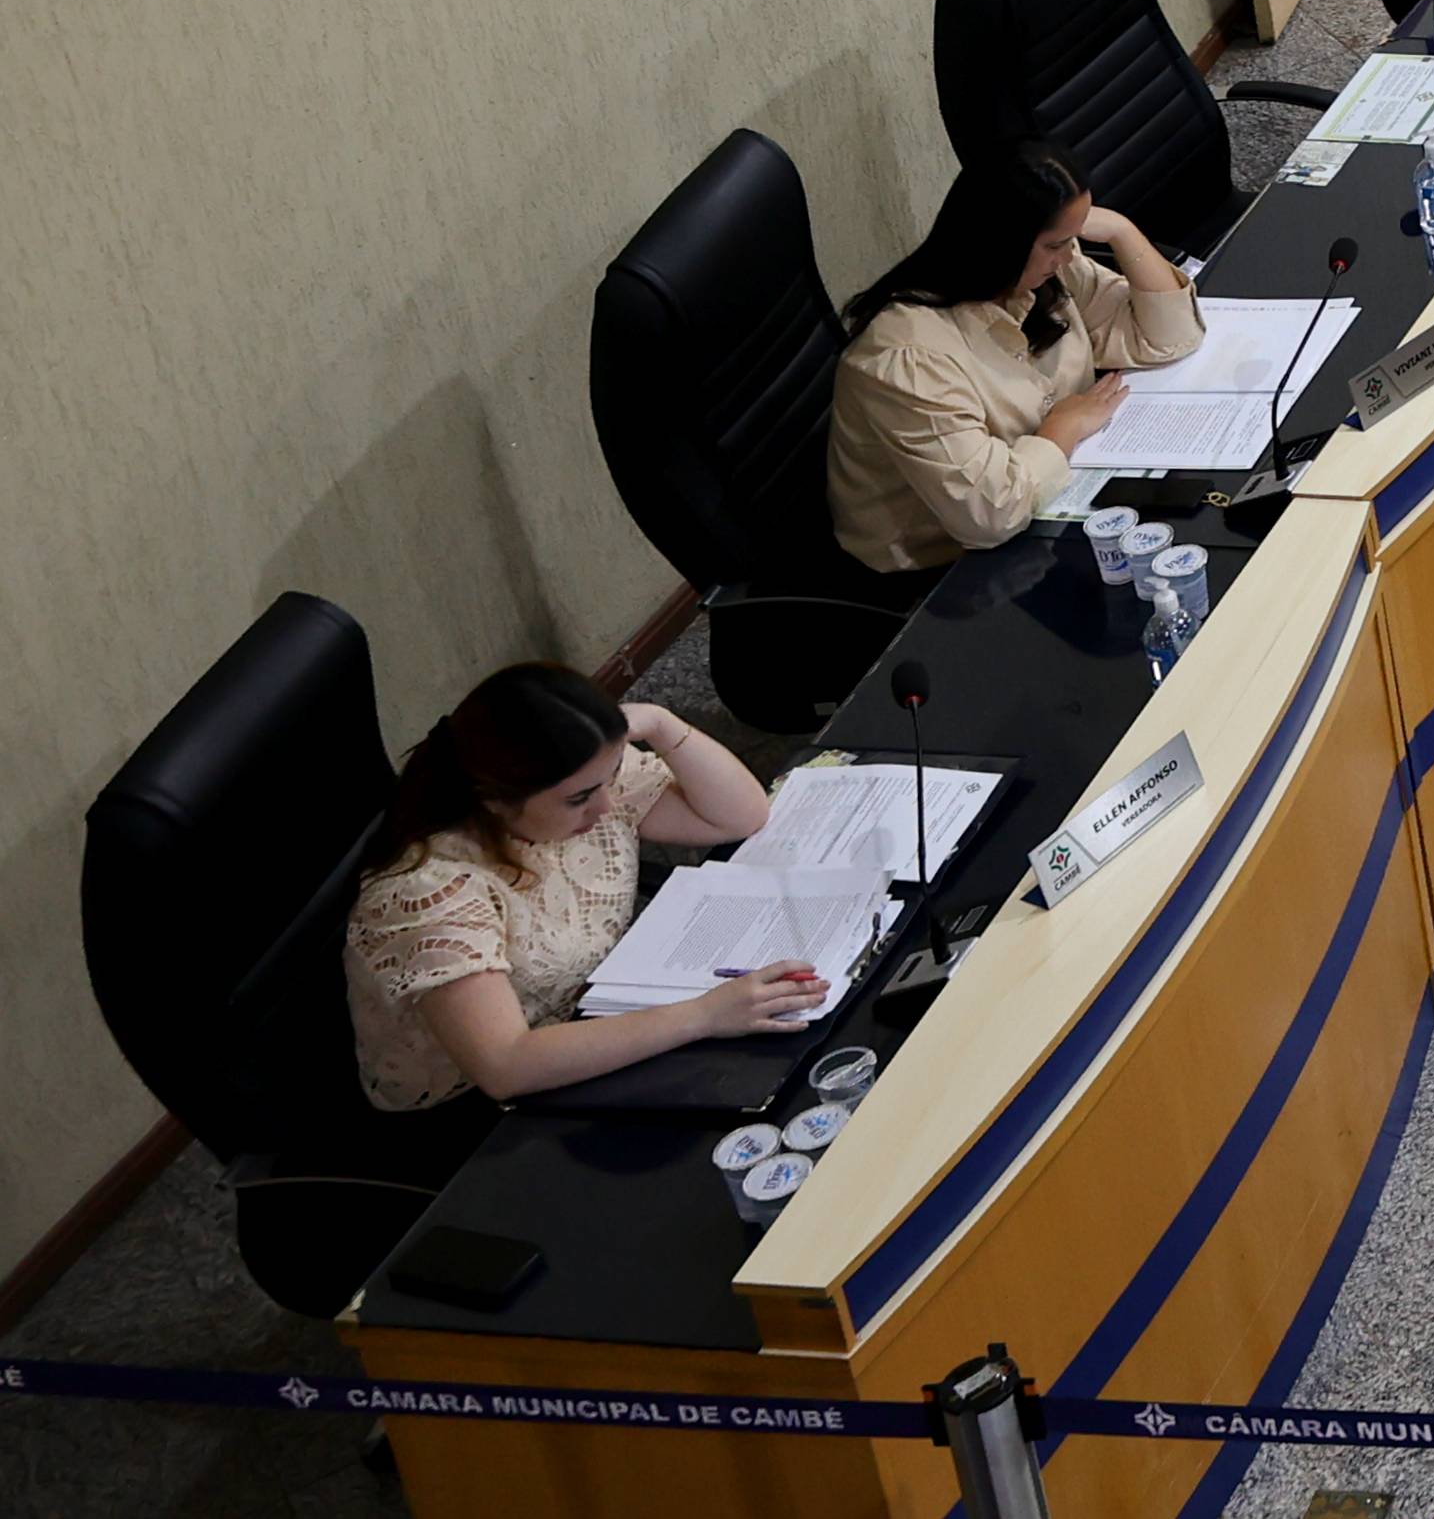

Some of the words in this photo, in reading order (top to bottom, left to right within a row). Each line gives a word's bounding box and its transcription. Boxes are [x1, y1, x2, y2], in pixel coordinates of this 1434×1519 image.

[1394, 346, 1433, 376] VIVIANI
[1092, 801, 1128, 834] ELLEN
[1128, 759, 1178, 806] AFFONSO
[1121, 792, 1162, 827] VEREADORA
[1054, 864, 1082, 891] CAMBÉ
[347, 1386, 483, 1413] CÂMARA
[492, 1394, 670, 1423] MUNICIPAL
[679, 1404, 722, 1425] DE
[731, 1406, 845, 1430] CAMBÉ
[1205, 1412, 1347, 1439] CÂMARA
